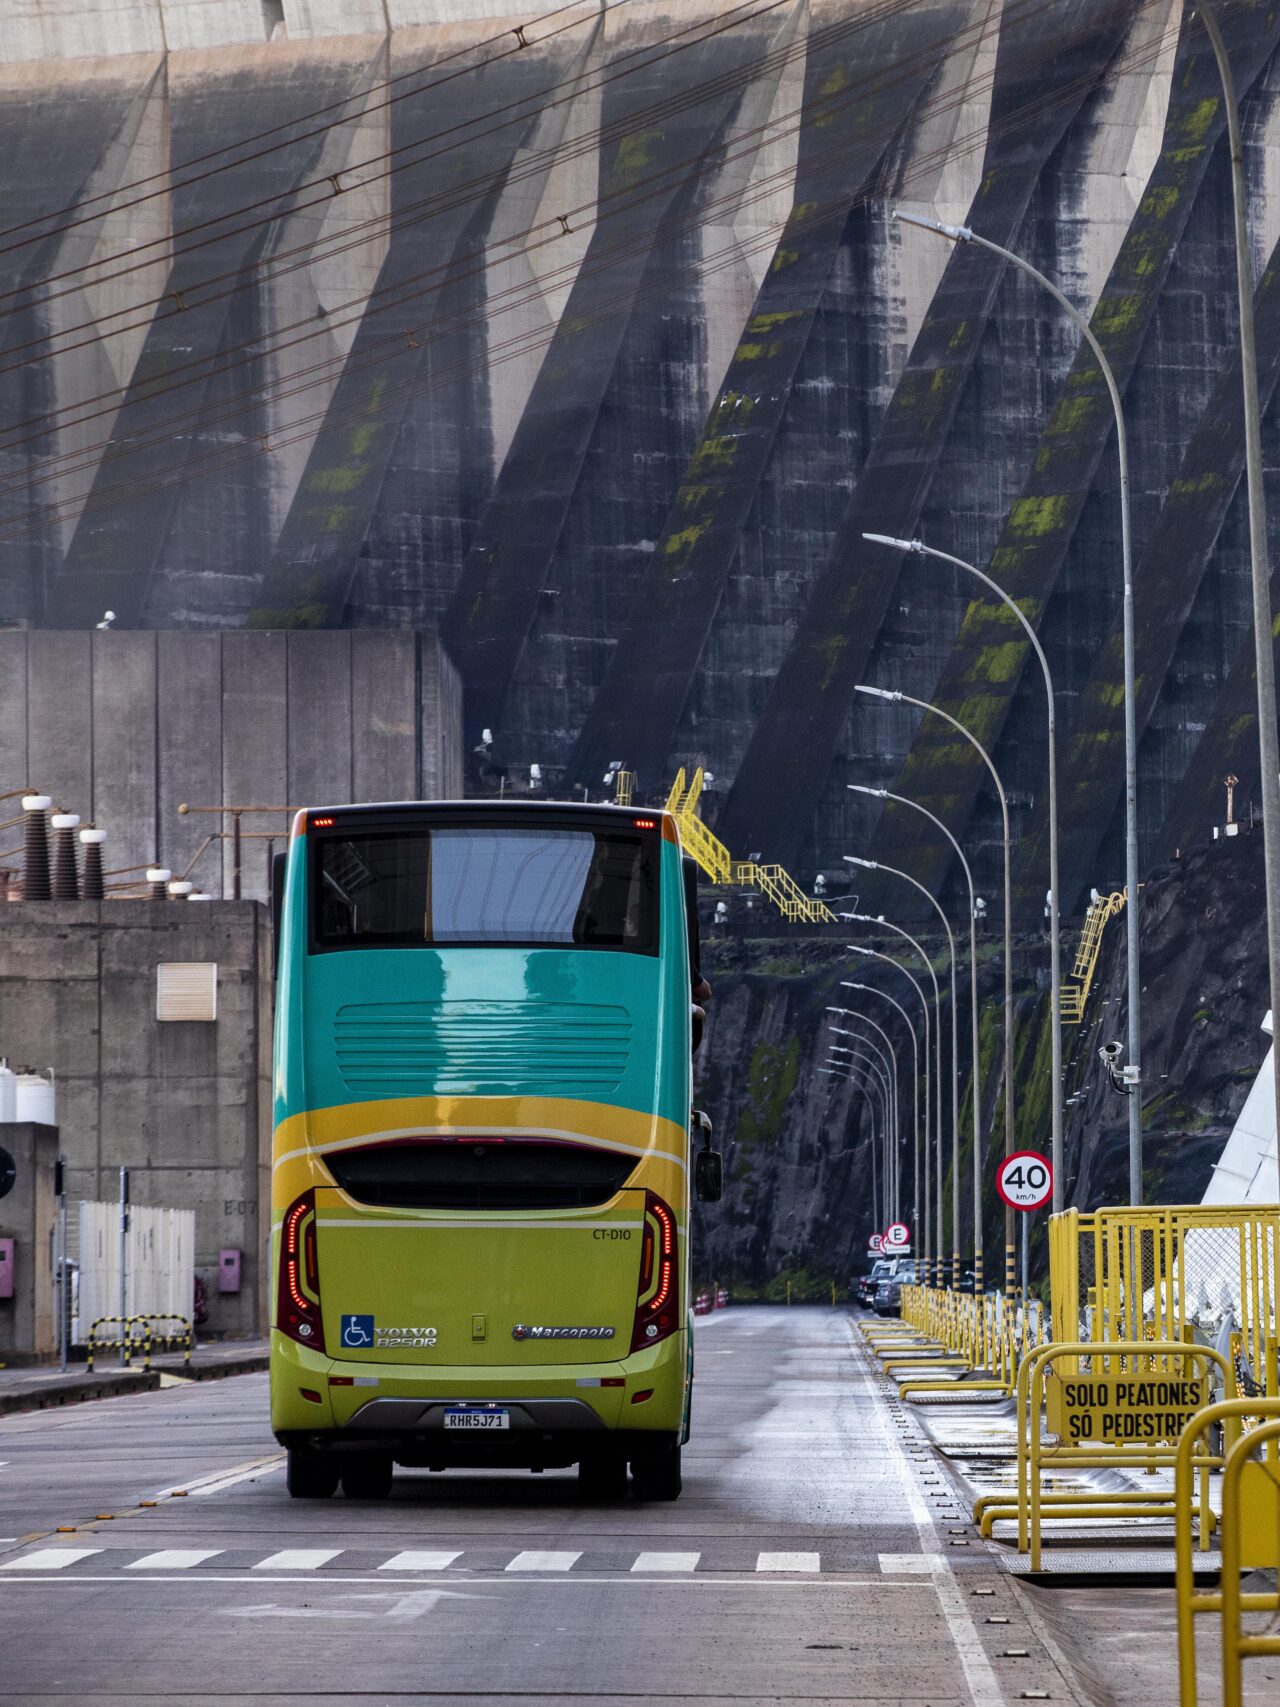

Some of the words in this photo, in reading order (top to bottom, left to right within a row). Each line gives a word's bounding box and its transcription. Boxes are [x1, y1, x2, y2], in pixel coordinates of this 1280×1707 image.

[1005, 1165, 1046, 1189] 40
[593, 1229, 631, 1241] CT-D10
[893, 1228, 902, 1240] E
[374, 1328, 437, 1338] VOLVO
[530, 1326, 614, 1338] Marcopolo
[1065, 1384, 1108, 1407] SOLO
[1115, 1382, 1200, 1407] PEATONES
[450, 1415, 503, 1427] RHR5J71
[1069, 1410, 1092, 1438] SÓ
[1102, 1413, 1196, 1437] PEDESTRE
